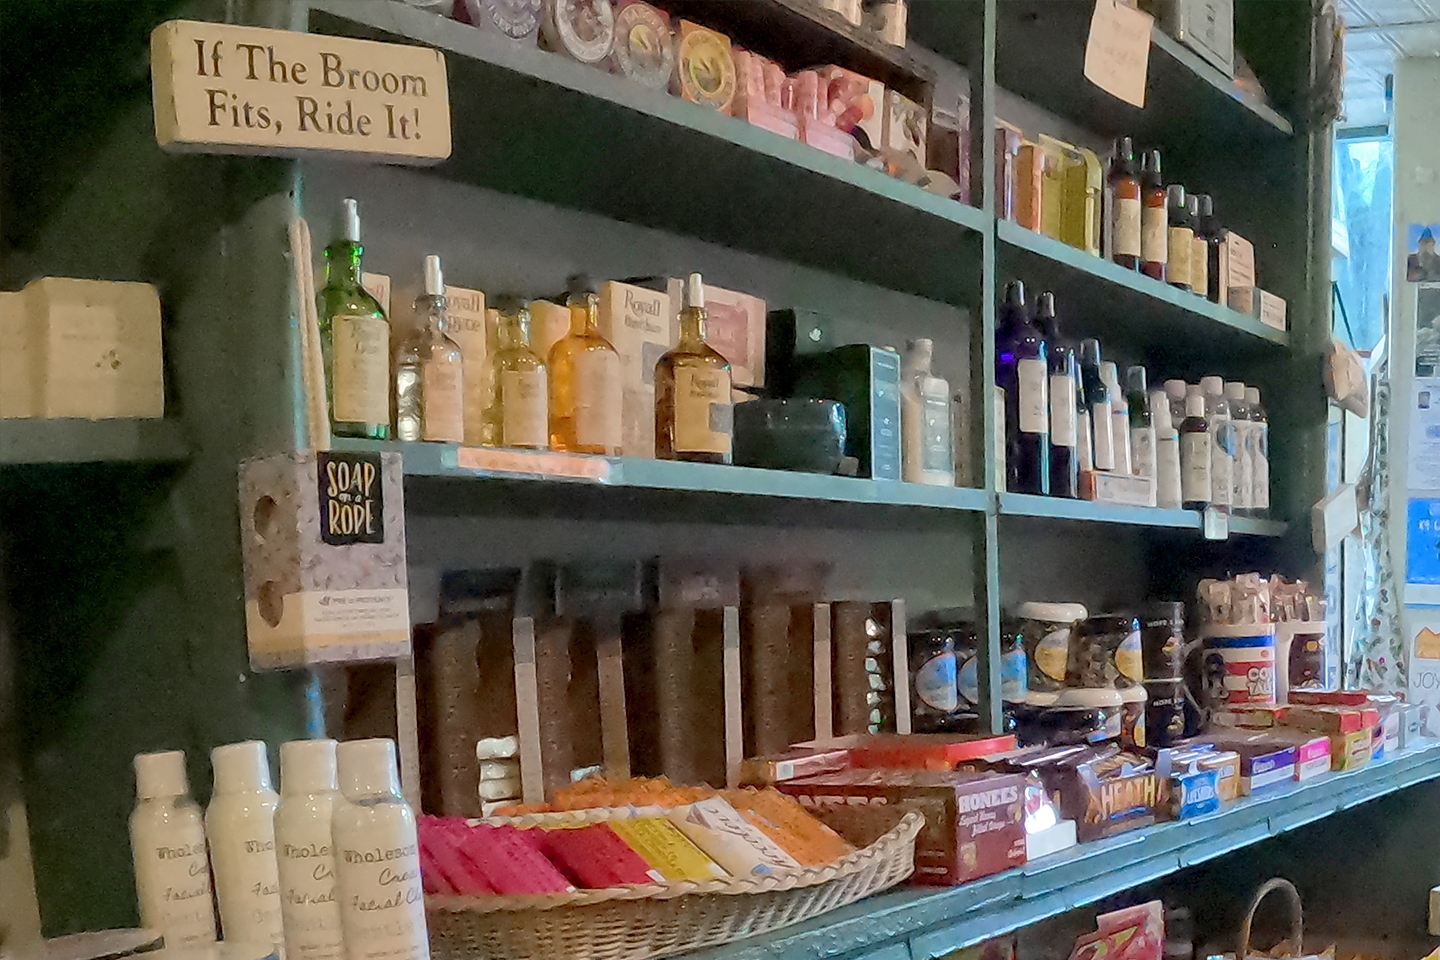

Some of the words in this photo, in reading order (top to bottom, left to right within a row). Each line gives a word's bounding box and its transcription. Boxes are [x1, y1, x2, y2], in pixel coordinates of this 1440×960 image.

[193, 38, 223, 78] If
[236, 43, 307, 85] The
[318, 52, 427, 97] Broom
[204, 88, 283, 135] Fits,
[296, 95, 372, 137] Ride
[383, 103, 422, 141] It!
[326, 460, 376, 498] SOAP
[328, 498, 377, 535] ROPE
[1101, 774, 1156, 821] HEATH
